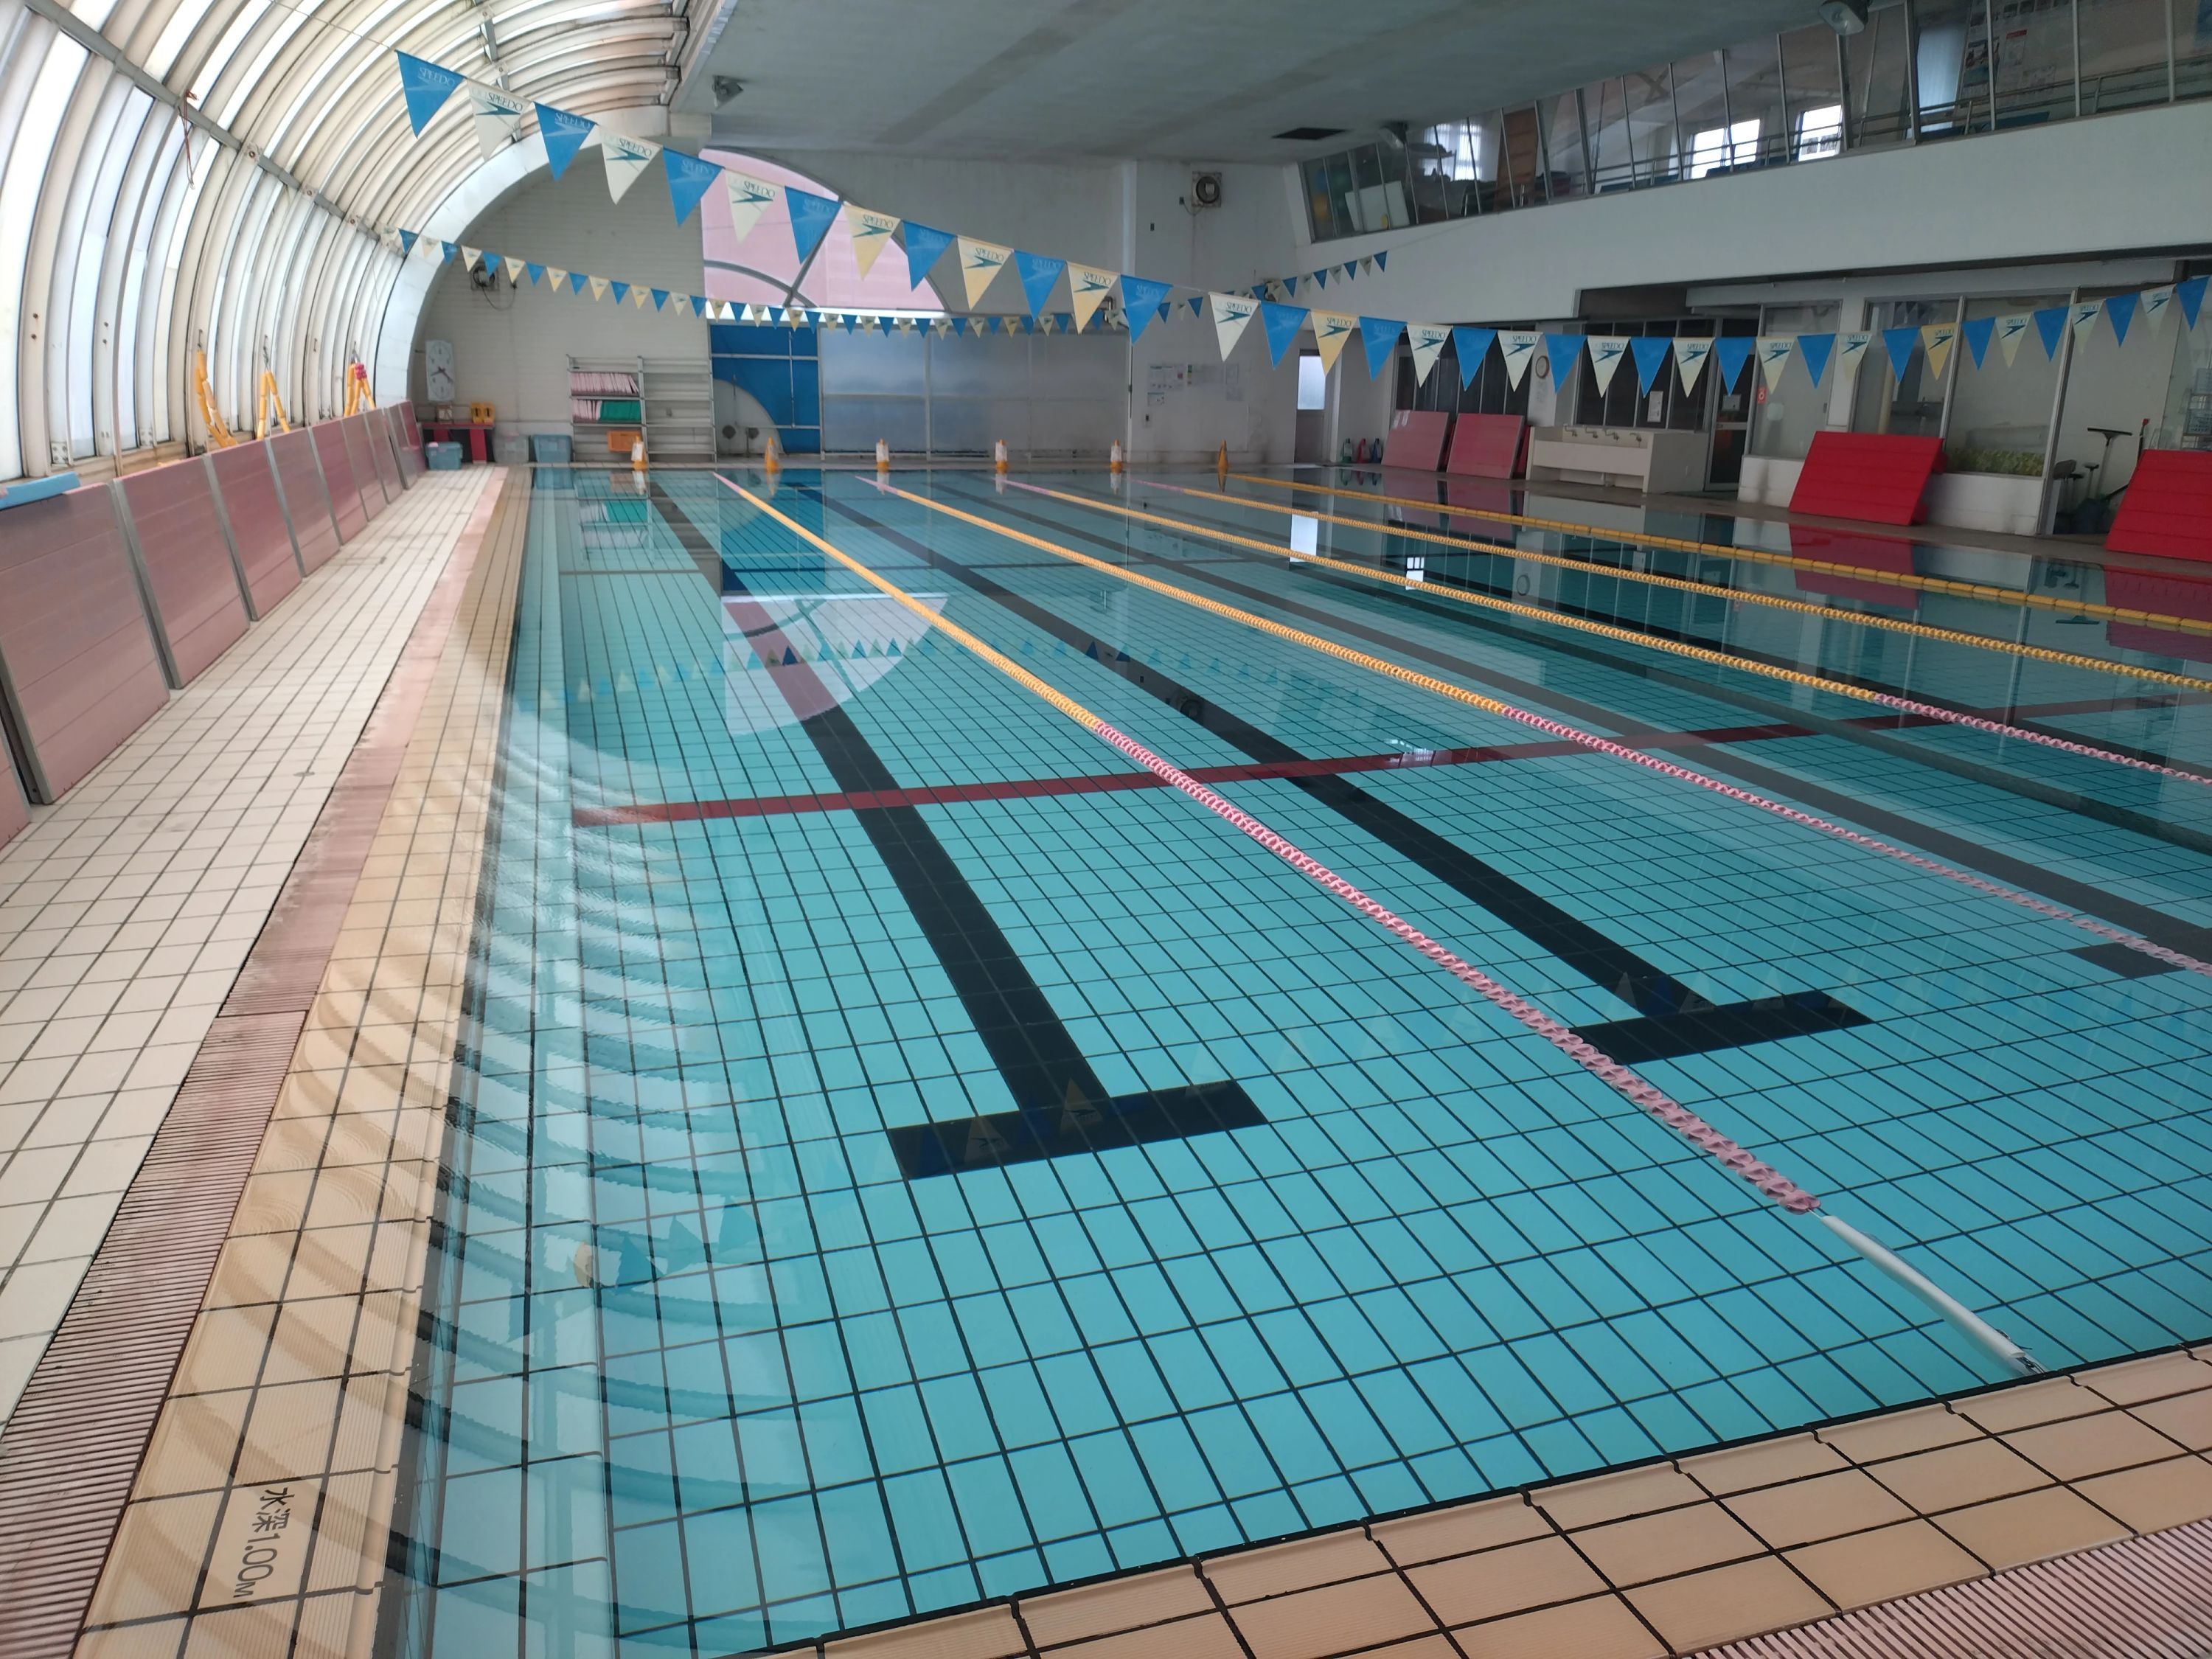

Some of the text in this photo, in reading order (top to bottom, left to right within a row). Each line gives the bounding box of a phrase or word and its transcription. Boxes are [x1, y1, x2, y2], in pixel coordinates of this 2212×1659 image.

[419, 67, 455, 87] SPEEDO
[487, 92, 524, 111] SPEEDO
[555, 112, 591, 129] SPEEDO
[619, 138, 652, 156] SPEEDO
[744, 181, 776, 198] SPEEDO
[863, 215, 894, 229] SPEEDO
[975, 247, 1004, 262] SPEEDO
[1084, 271, 1112, 285] SPEEDO
[1226, 302, 1252, 313] SPEEDO
[1326, 317, 1352, 327] SPEEDO
[1422, 330, 1446, 338] SPEEDO
[1846, 334, 1868, 342] SPEEDO
